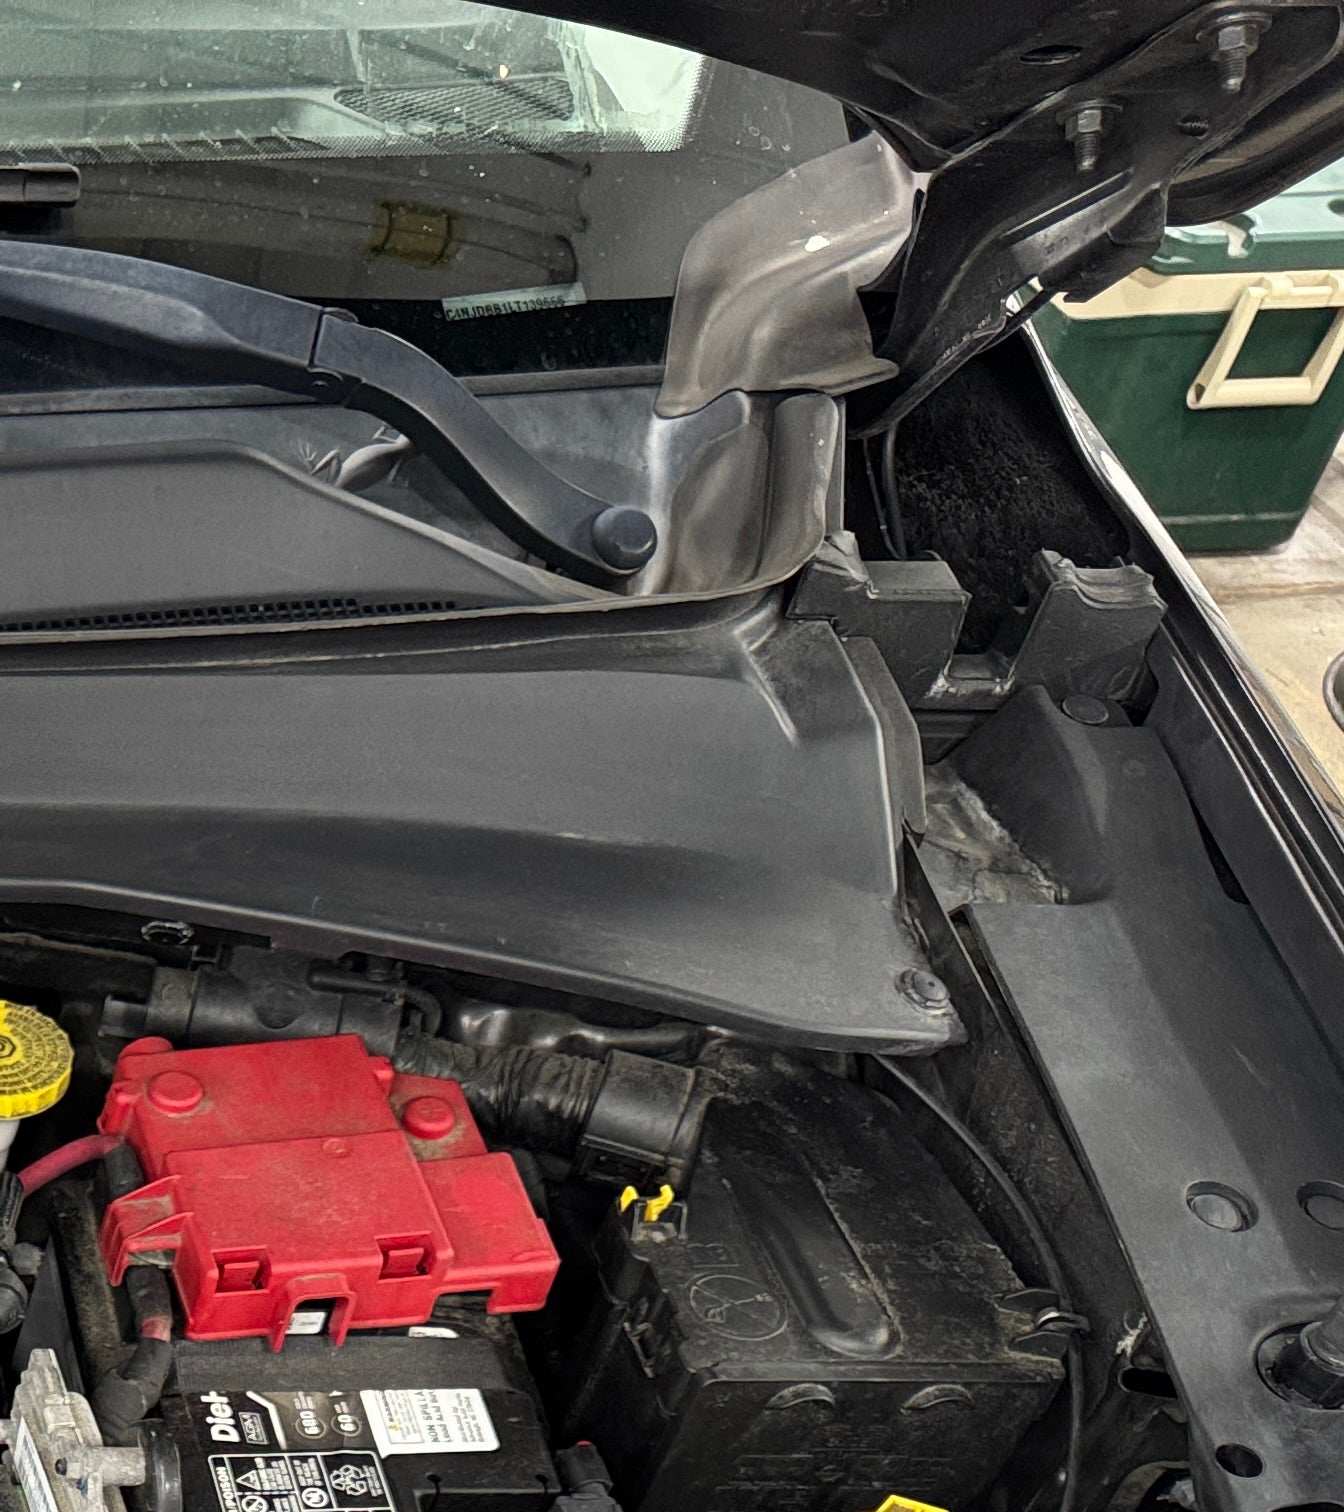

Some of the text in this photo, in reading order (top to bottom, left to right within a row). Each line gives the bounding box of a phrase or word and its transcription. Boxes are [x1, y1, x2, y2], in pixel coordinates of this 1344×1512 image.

[240, 1414, 257, 1440] AGM
[337, 1414, 354, 1432] 60
[426, 1424, 441, 1443] NON
